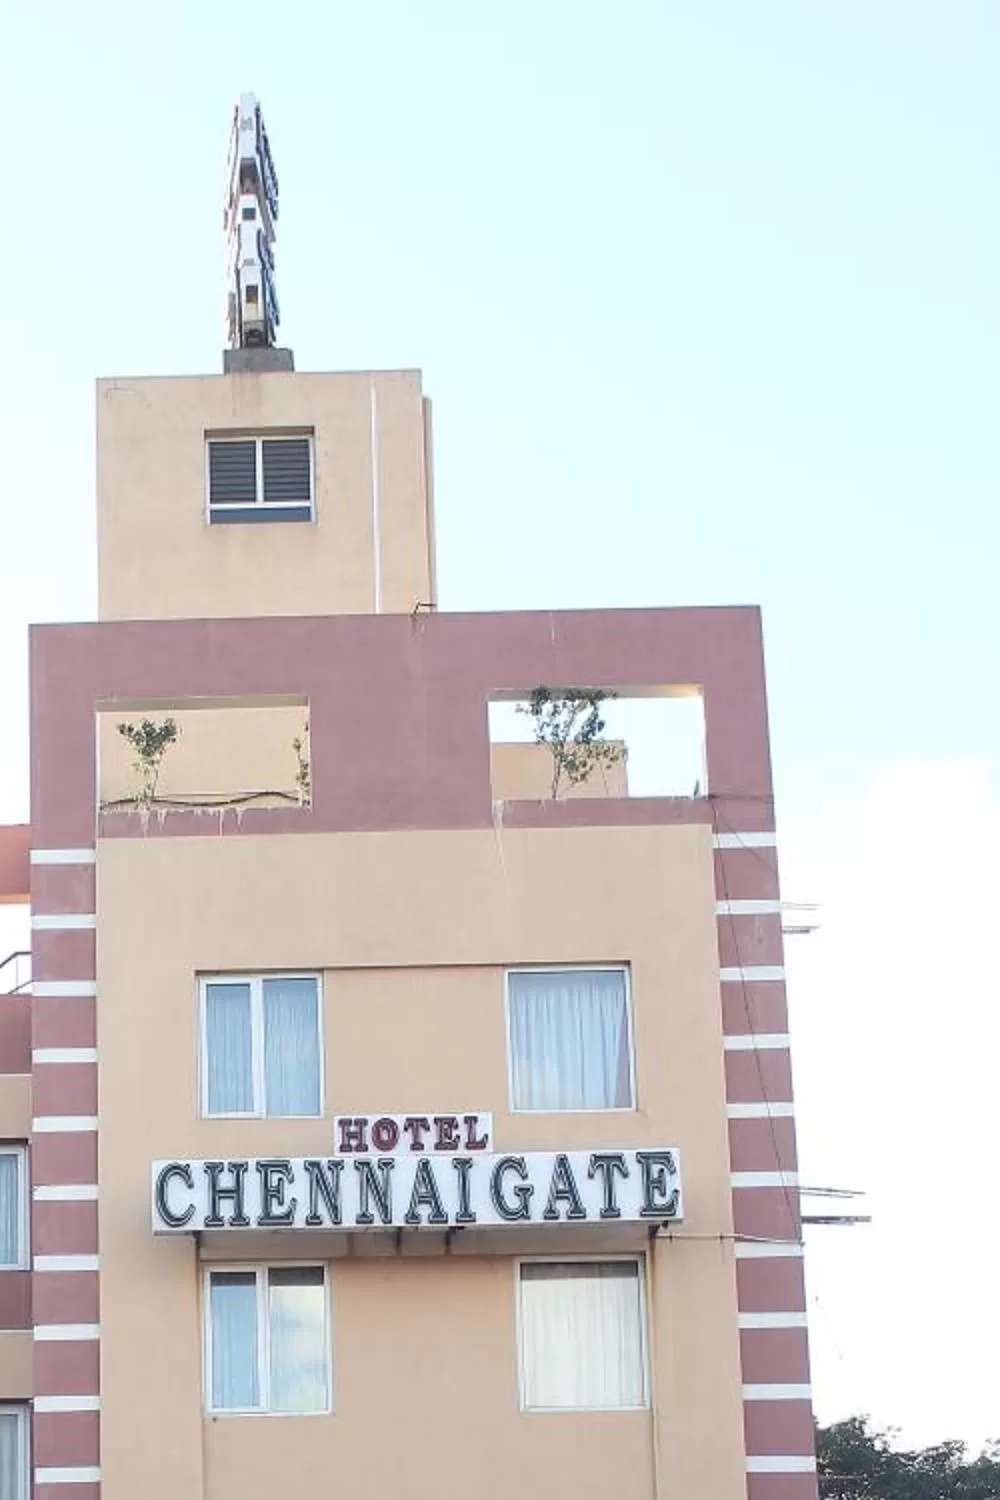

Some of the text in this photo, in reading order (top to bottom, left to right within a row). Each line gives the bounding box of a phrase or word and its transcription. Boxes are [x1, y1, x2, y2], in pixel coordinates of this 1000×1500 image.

[338, 1116, 489, 1152] HOTEL
[155, 1150, 680, 1228] CHENNAI GATE
